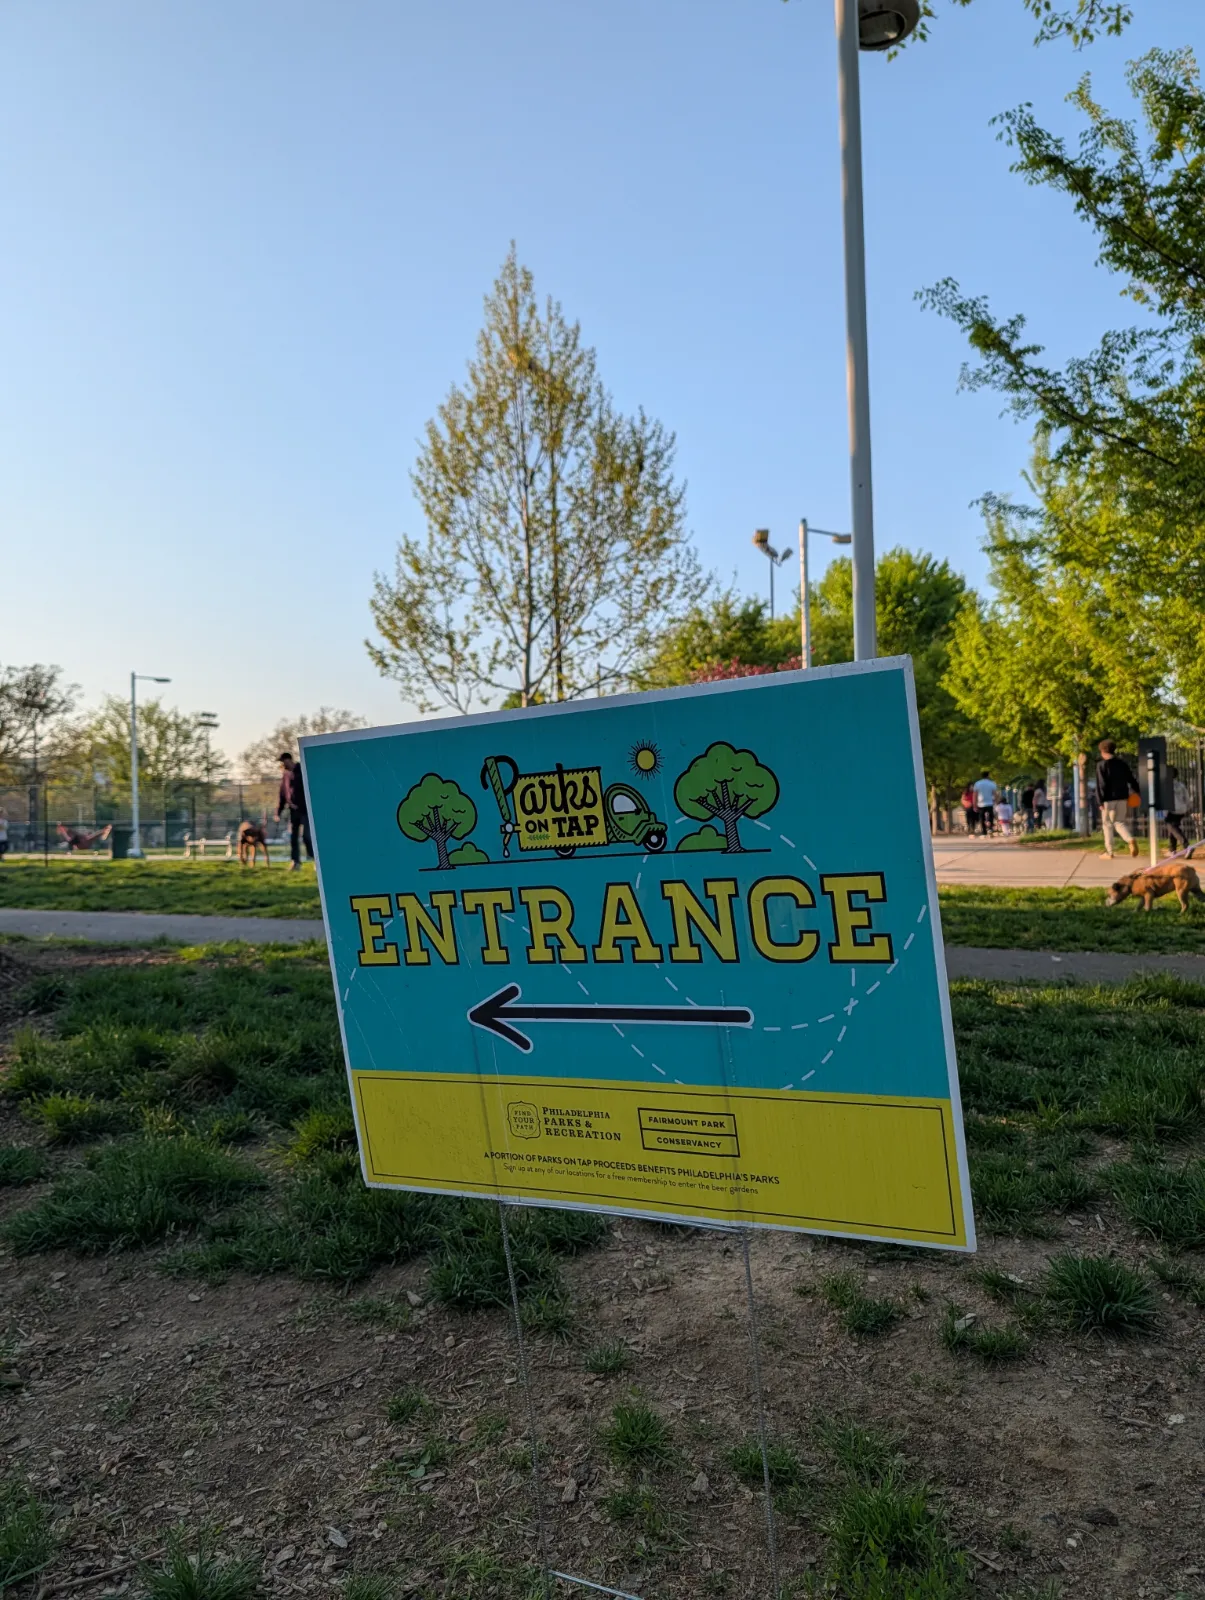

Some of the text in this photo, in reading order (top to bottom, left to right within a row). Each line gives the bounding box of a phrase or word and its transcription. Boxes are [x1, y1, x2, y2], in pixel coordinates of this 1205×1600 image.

[481, 755, 598, 816] Parks
[525, 814, 599, 838] ON TAP
[350, 872, 894, 966] ENTRANCE
[541, 1106, 611, 1119] PHILADELPHIA
[513, 1116, 535, 1124] YOUR
[544, 1117, 593, 1128] PARKS &
[648, 1116, 726, 1129] FAIRMOUNT PARK
[545, 1127, 622, 1141] RECREATION
[656, 1136, 722, 1149] CONSERVANCY
[484, 1151, 780, 1185] A PORTION OF PARKS ON TAP PROCEEDS BENEFITS PHILADELPHIA'S PARKS
[503, 1162, 517, 1173] Sign
[518, 1165, 526, 1173] up
[535, 1167, 545, 1176] any
[547, 1166, 554, 1174] of
[566, 1168, 595, 1178] locations
[611, 1173, 626, 1181] free
[627, 1175, 668, 1188] membership
[669, 1179, 677, 1187] to
[678, 1181, 697, 1189] enter
[698, 1182, 710, 1191] the
[712, 1184, 727, 1192] beer
[729, 1185, 759, 1195] gardens
